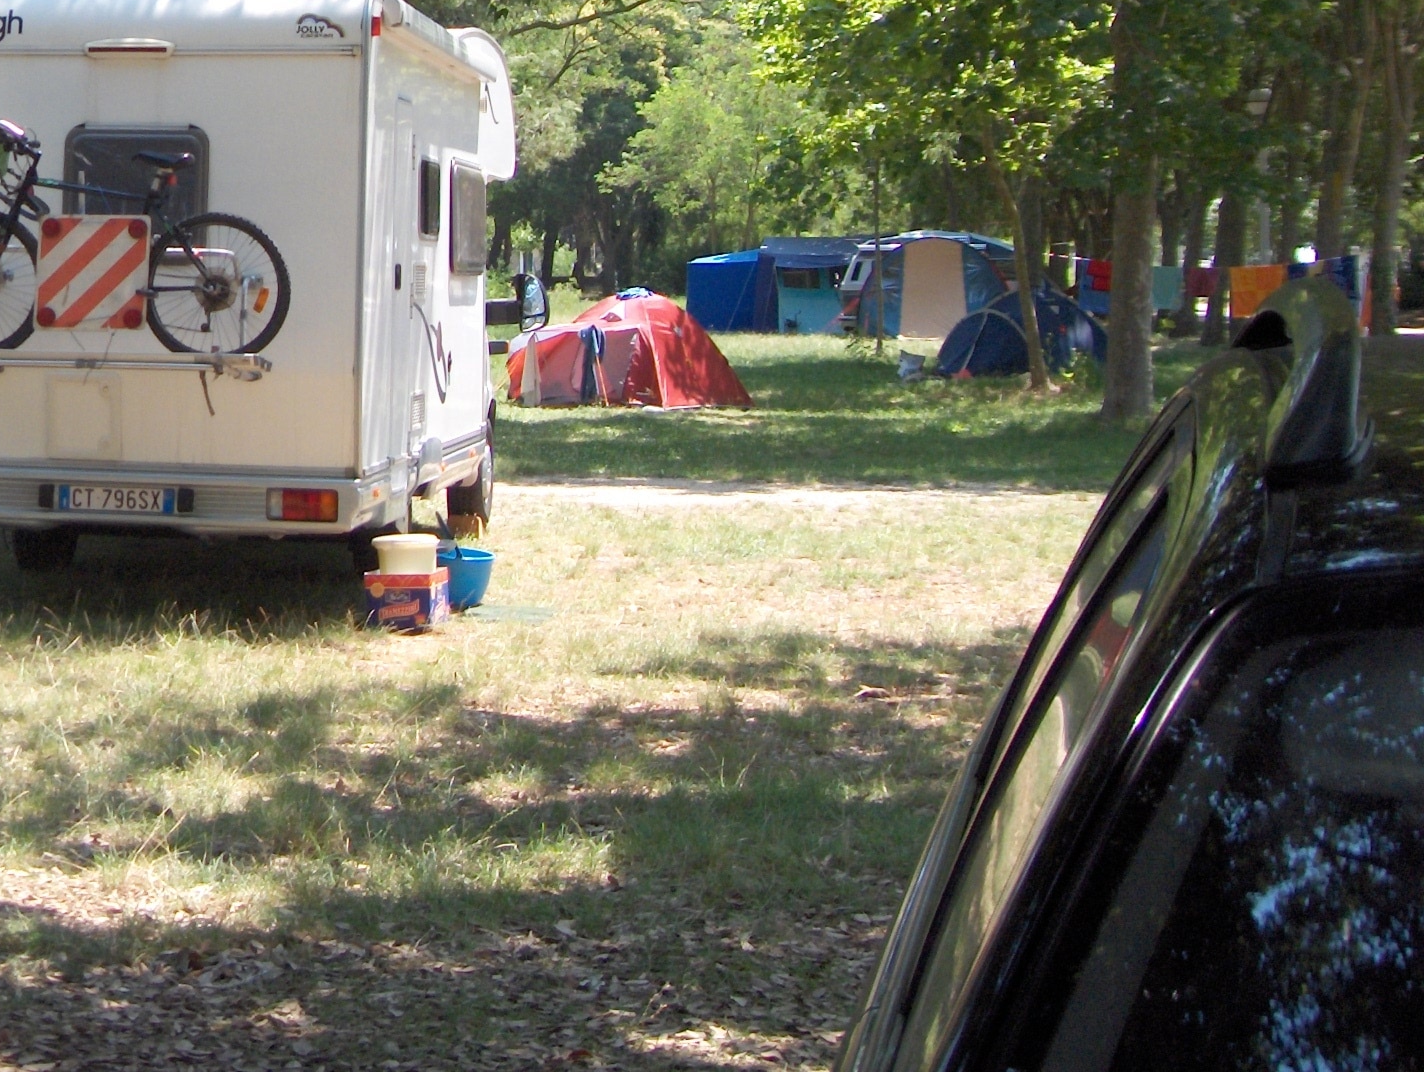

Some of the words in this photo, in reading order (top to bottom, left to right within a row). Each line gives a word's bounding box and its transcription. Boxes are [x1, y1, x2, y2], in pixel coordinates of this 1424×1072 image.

[296, 25, 325, 34] JOLLY
[72, 488, 95, 508] CT
[102, 489, 162, 510] 796SX
